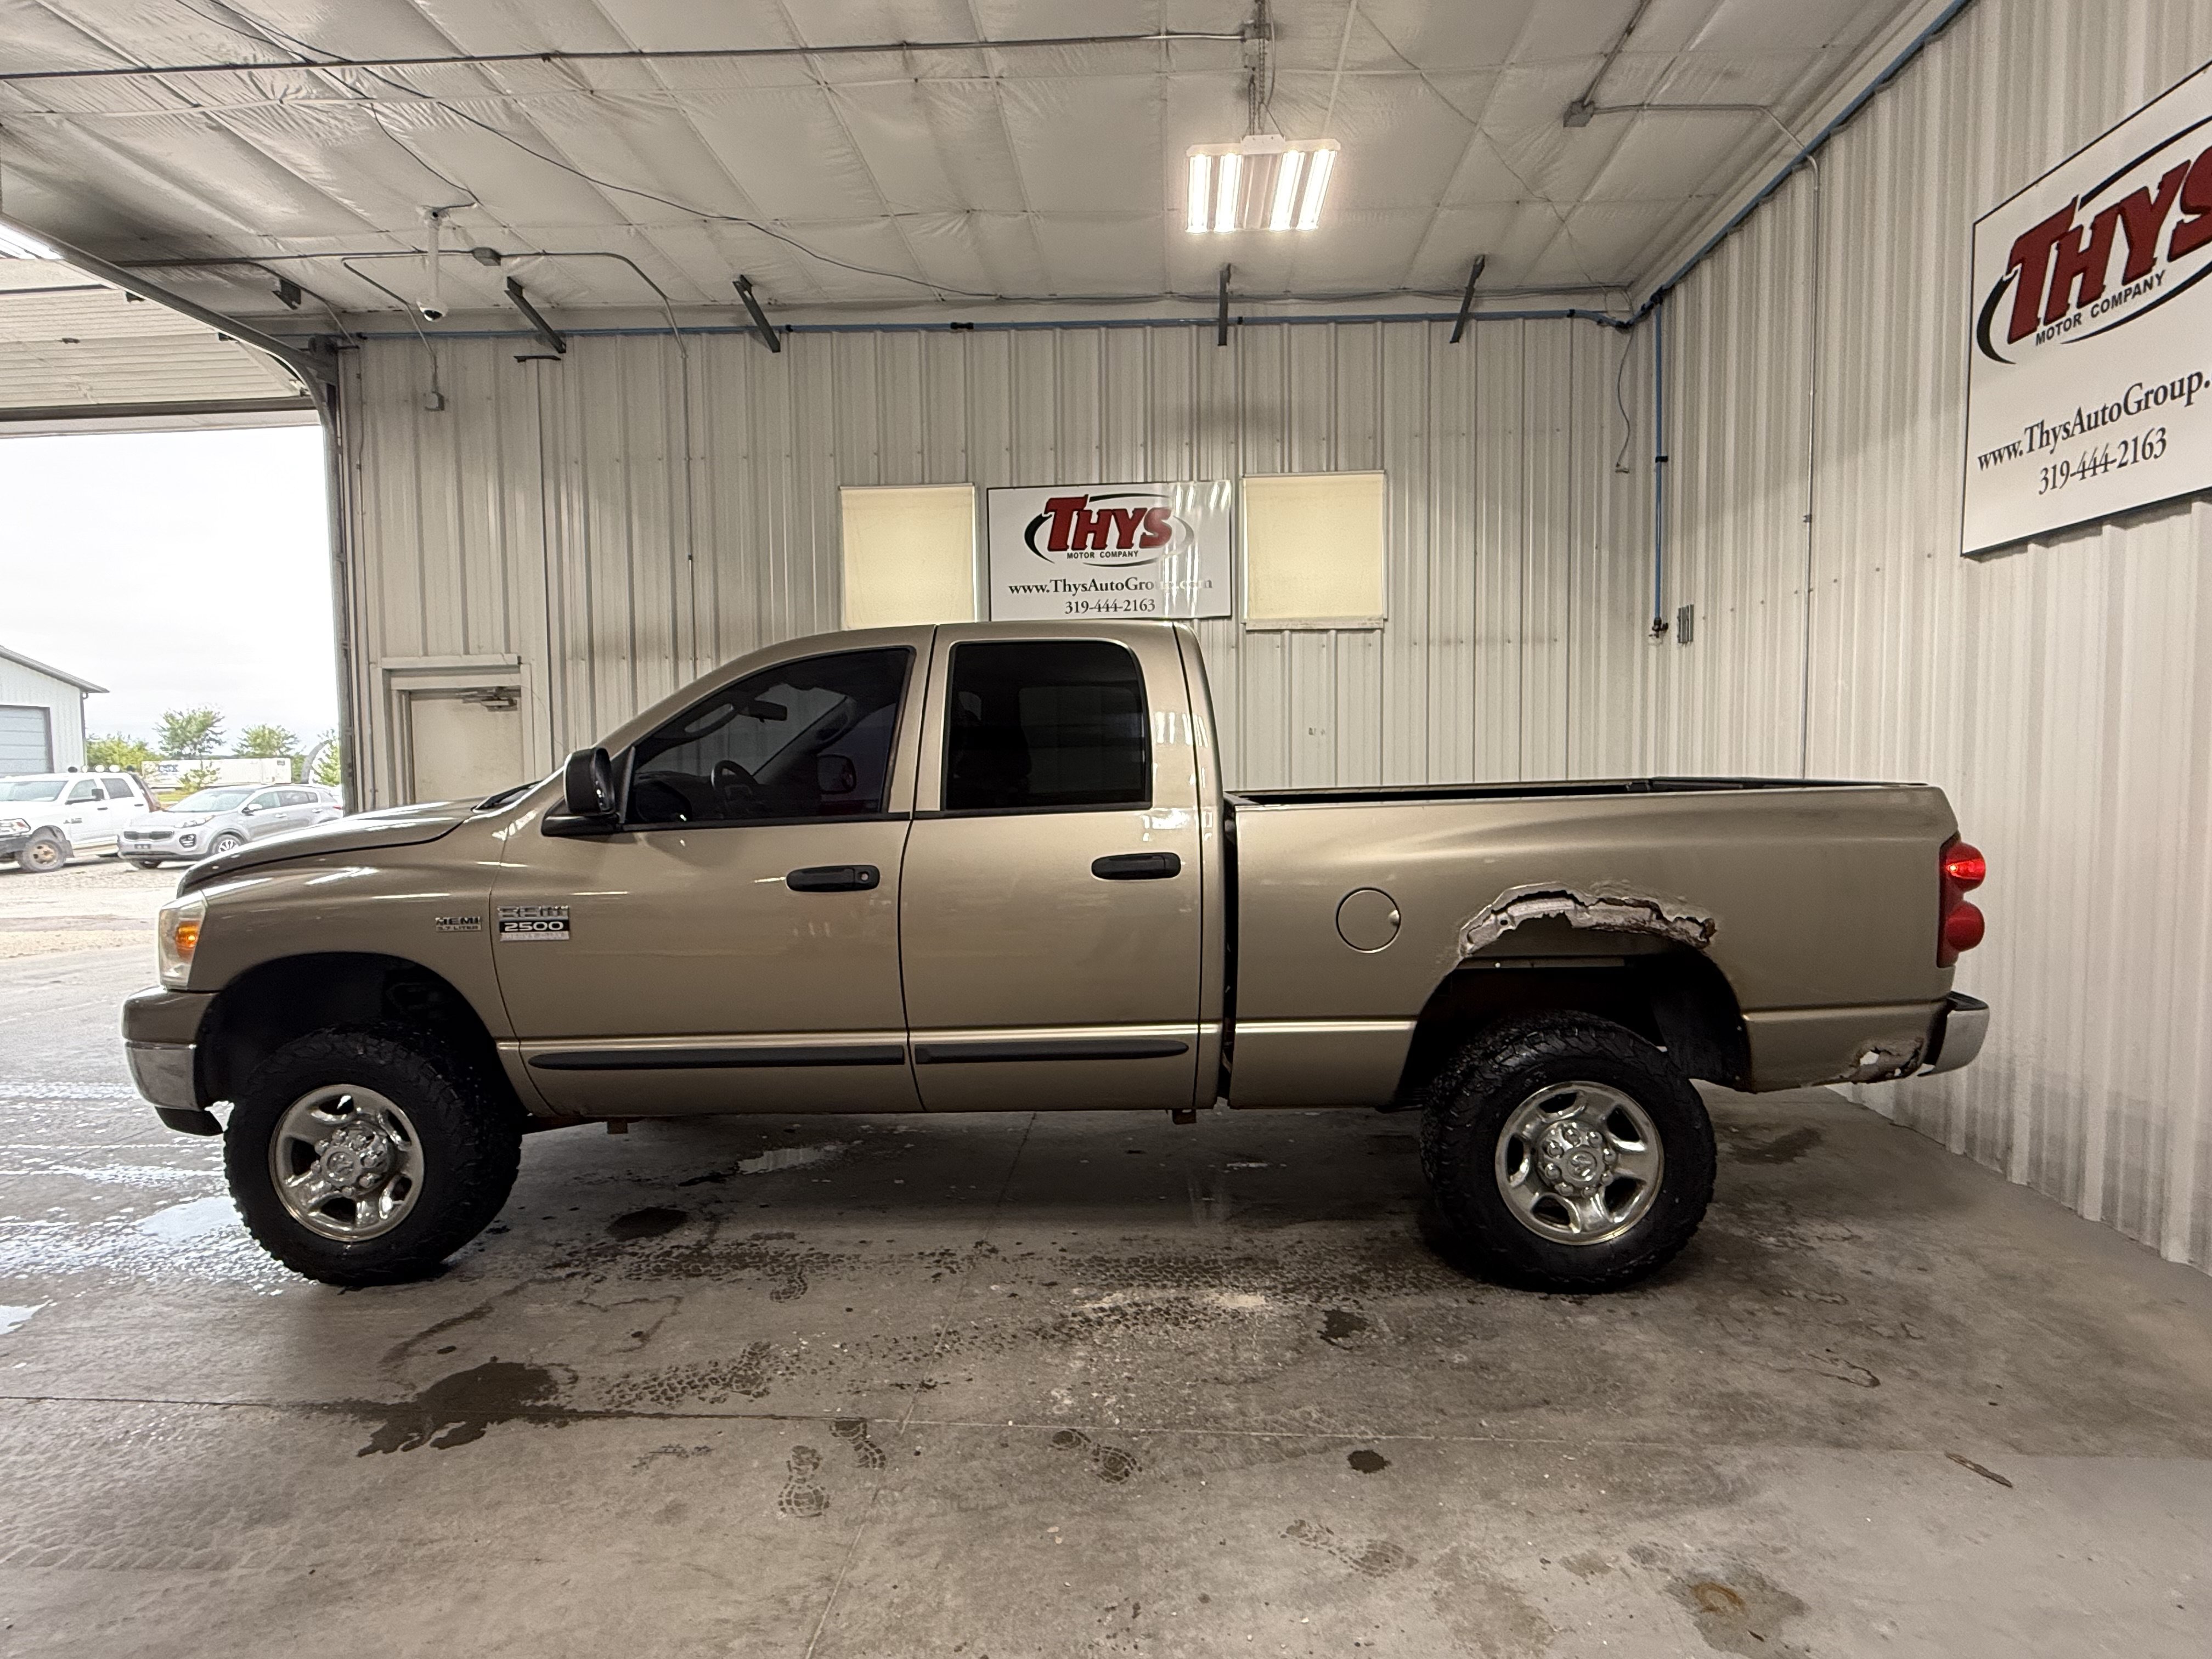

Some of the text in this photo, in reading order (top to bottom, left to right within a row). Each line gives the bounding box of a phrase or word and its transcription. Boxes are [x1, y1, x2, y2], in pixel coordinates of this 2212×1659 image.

[2035, 270, 2167, 346] MOTOR COMPANY
[2038, 426, 2167, 495] 319-444-2163
[1044, 494, 1173, 552] THYS
[1099, 550, 1139, 558] COMPANY
[1064, 598, 1156, 614] 319-444-2163
[435, 916, 481, 925] HEMI
[504, 921, 564, 932] 2500
